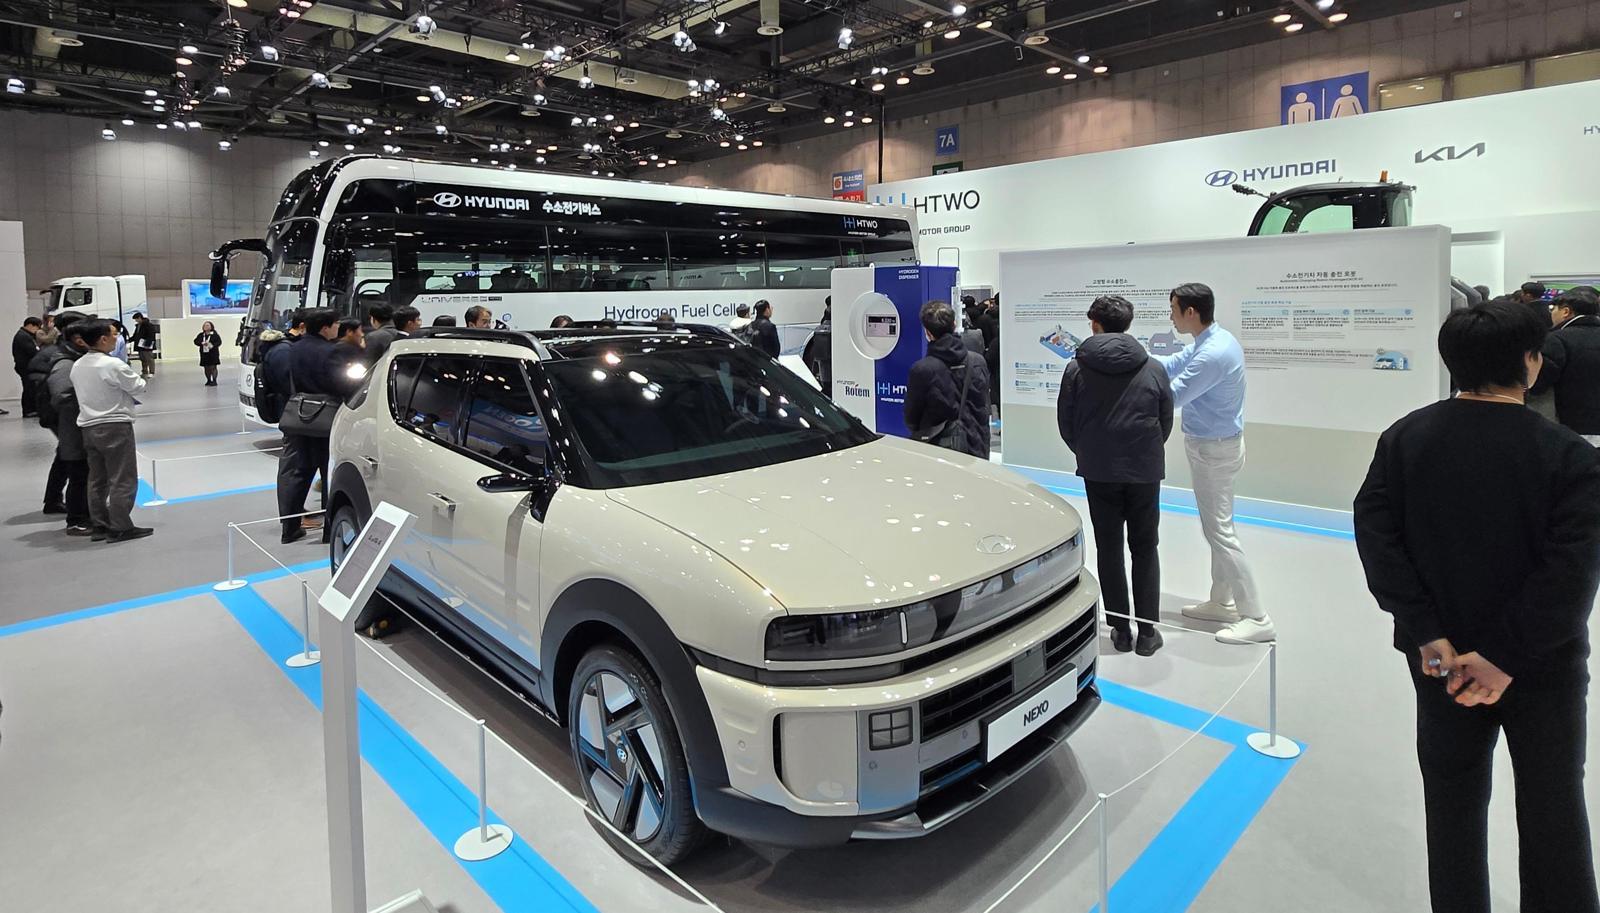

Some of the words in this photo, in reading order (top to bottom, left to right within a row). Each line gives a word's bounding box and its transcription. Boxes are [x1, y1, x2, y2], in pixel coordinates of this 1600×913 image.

[939, 133, 956, 148] 7A
[1414, 141, 1486, 164] KIA
[1243, 159, 1336, 183] HYUNDAI
[464, 195, 530, 211] HYUNDAI
[542, 200, 601, 216] 수소전기버스
[914, 190, 980, 214] HTWO
[856, 218, 878, 229] HTWO
[943, 224, 971, 234] GROUP
[604, 305, 677, 321] Hydrogen
[681, 303, 709, 318] Fuel
[712, 303, 736, 317] Cell
[845, 384, 870, 398] Rotem
[1023, 700, 1049, 726] NEXO
